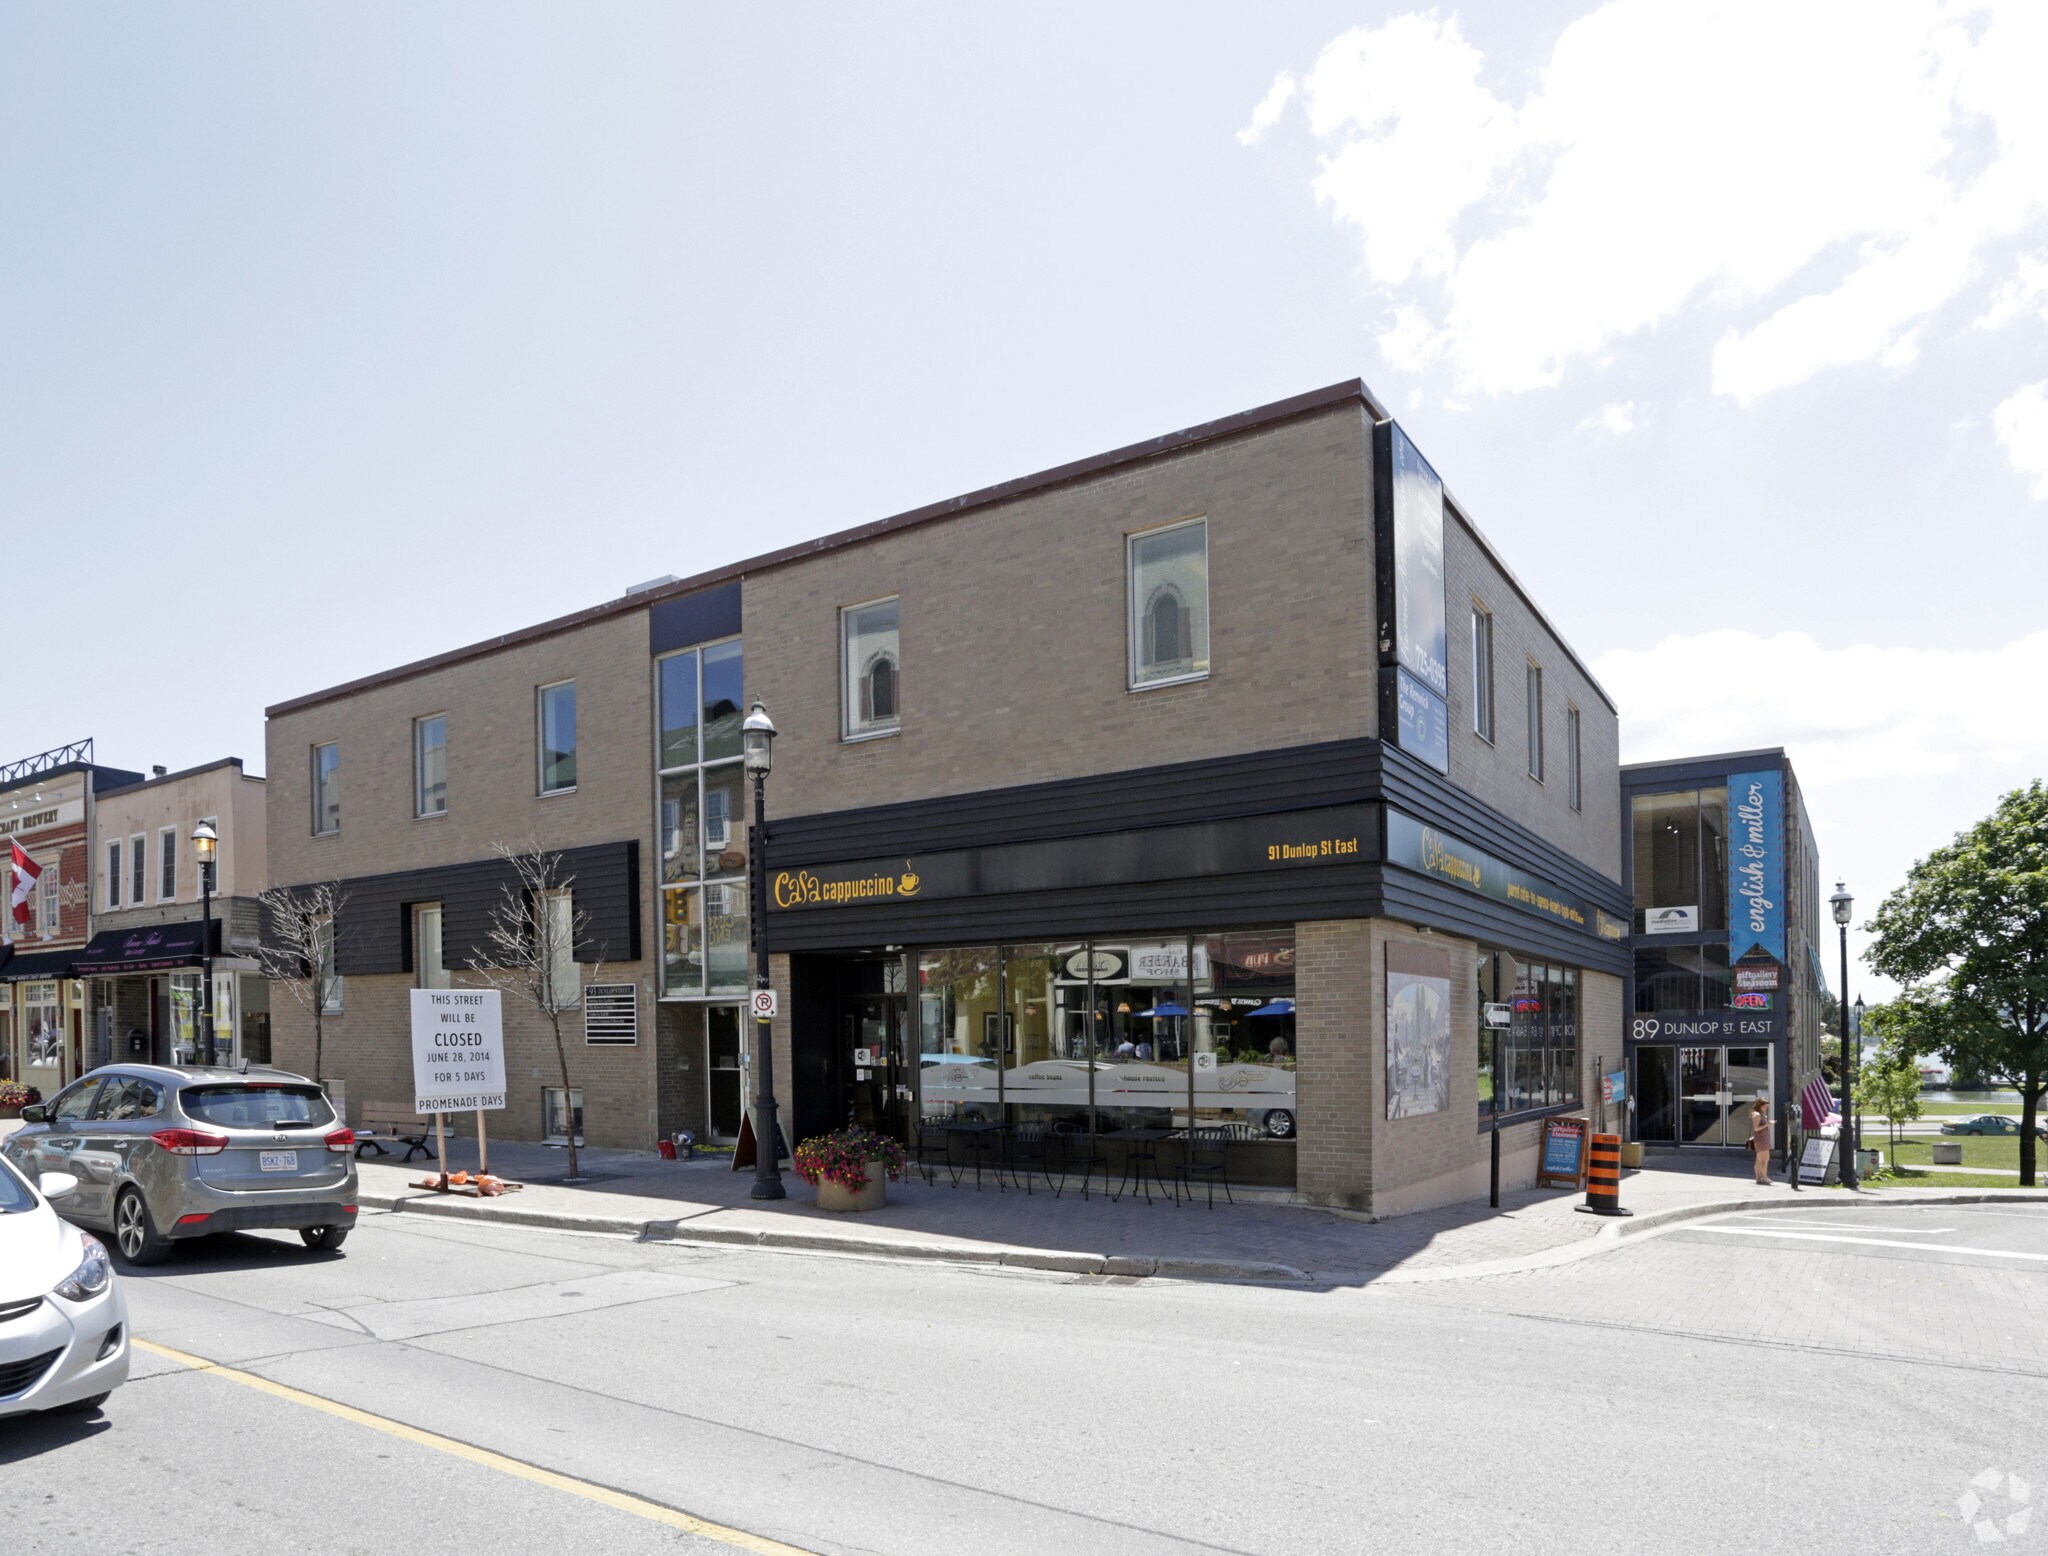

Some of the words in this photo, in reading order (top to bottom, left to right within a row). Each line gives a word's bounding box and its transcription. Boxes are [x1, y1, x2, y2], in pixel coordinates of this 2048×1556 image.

[1415, 643, 1446, 690] 725-0395
[1400, 676, 1409, 696] The
[1409, 684, 1429, 710] Renwick
[1400, 694, 1415, 720] Group
[22, 808, 58, 829] BREWERY
[1738, 781, 1764, 844] miller
[1268, 845, 1280, 860] 91
[1282, 842, 1318, 859] Dunlop
[1320, 840, 1332, 855] St
[1335, 837, 1358, 854] East
[822, 873, 893, 903] cappuccino
[1738, 860, 1773, 933] english
[431, 995, 450, 1004] THIS
[454, 995, 484, 1005] STREET
[1733, 995, 1766, 1007] OPEN
[440, 1013, 461, 1023] WILL
[465, 1013, 475, 1023] BE
[1633, 1019, 1660, 1039] 89
[1664, 1021, 1719, 1035] DUNLOP
[1740, 1020, 1773, 1034] EAST
[434, 1032, 482, 1047] CLOSED
[427, 1052, 449, 1063] JUNE
[452, 1052, 467, 1063] 28,
[470, 1052, 490, 1062] 2014
[434, 1072, 452, 1082] FOR
[455, 1072, 461, 1082] 5
[464, 1071, 486, 1082] DAYS
[419, 1096, 478, 1110] PROMENADE
[481, 1095, 503, 1107] DAYS
[282, 1156, 296, 1166] 768
